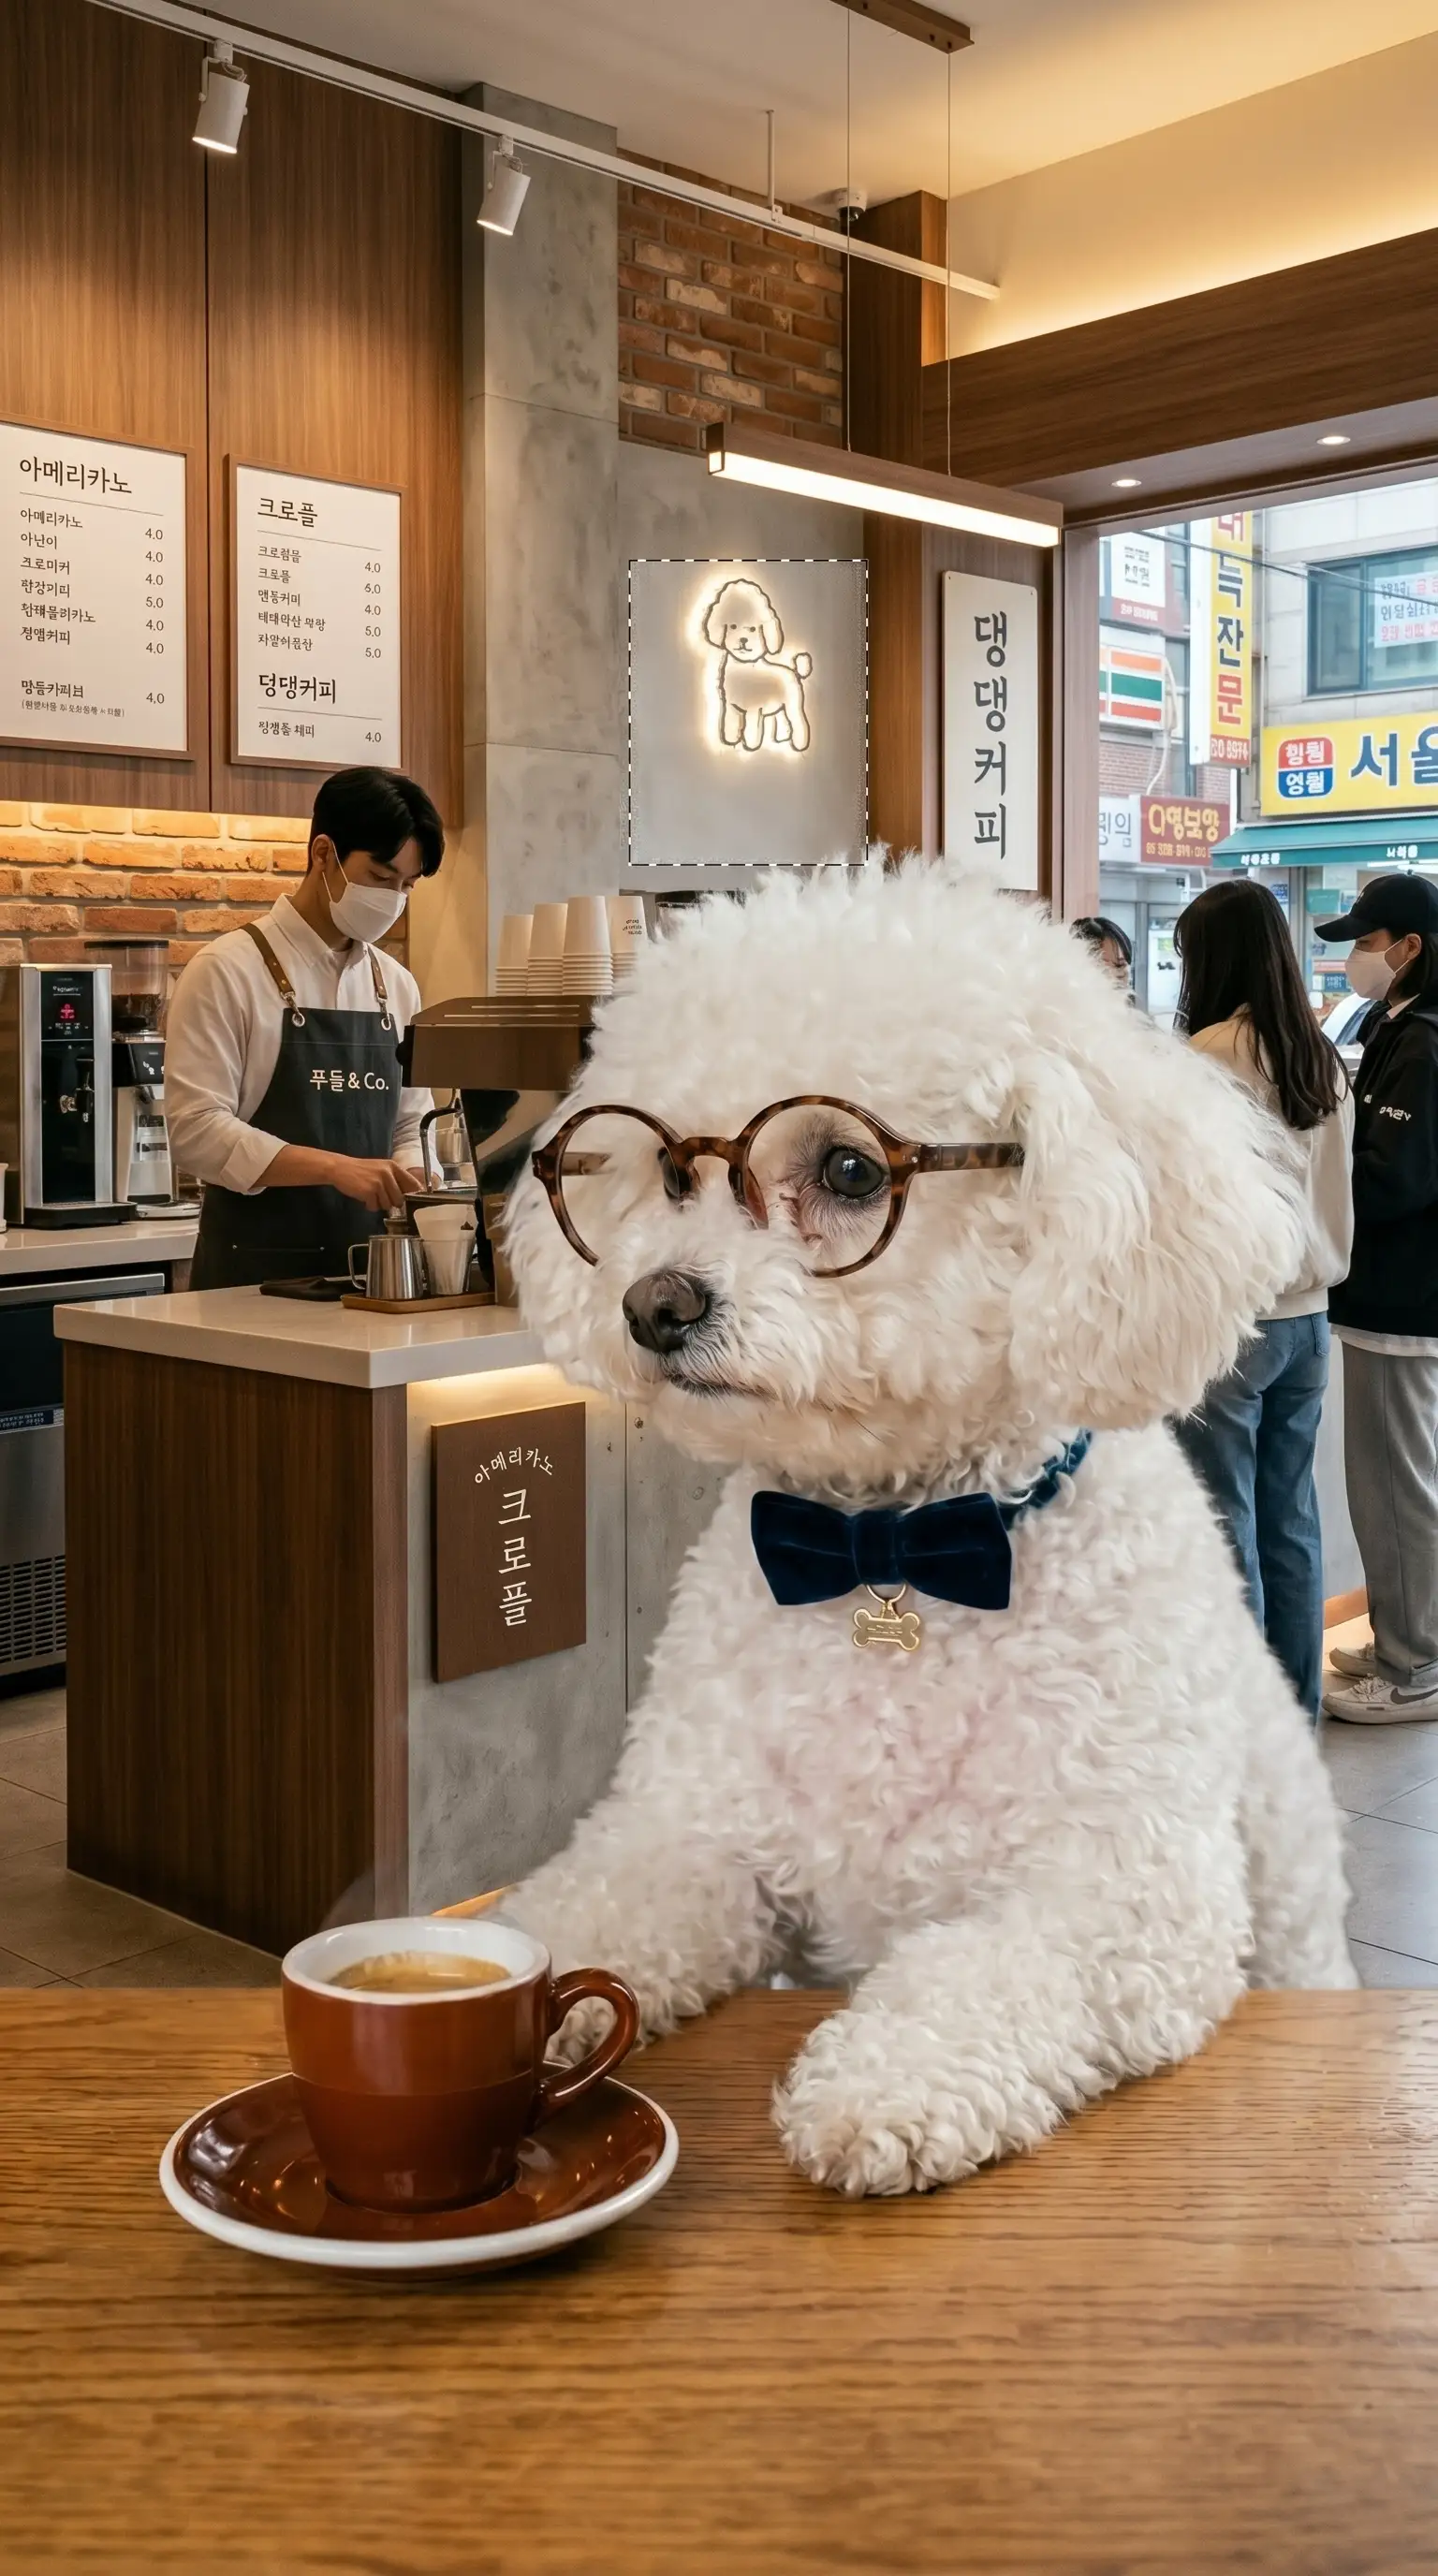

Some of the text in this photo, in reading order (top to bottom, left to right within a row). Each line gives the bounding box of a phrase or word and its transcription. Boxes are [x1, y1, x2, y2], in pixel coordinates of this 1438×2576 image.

[19, 456, 132, 494] 아메리카노
[257, 497, 318, 528] 크로플
[20, 507, 164, 540] 아메리카노 4.0
[145, 550, 164, 564] 4.0
[364, 562, 381, 573] 4.0
[145, 573, 164, 586] 4.0
[145, 596, 164, 608] 5.0
[364, 604, 381, 616] 4.0
[145, 619, 164, 632] 4.0
[365, 625, 381, 637] 5.0
[145, 642, 165, 654] 4.0
[365, 647, 382, 659] 5.0
[365, 731, 382, 743] 4.0
[973, 610, 1007, 859] 댕댕커피
[475, 1446, 553, 1484] 아메리카노
[498, 1488, 533, 1627] 크로플
